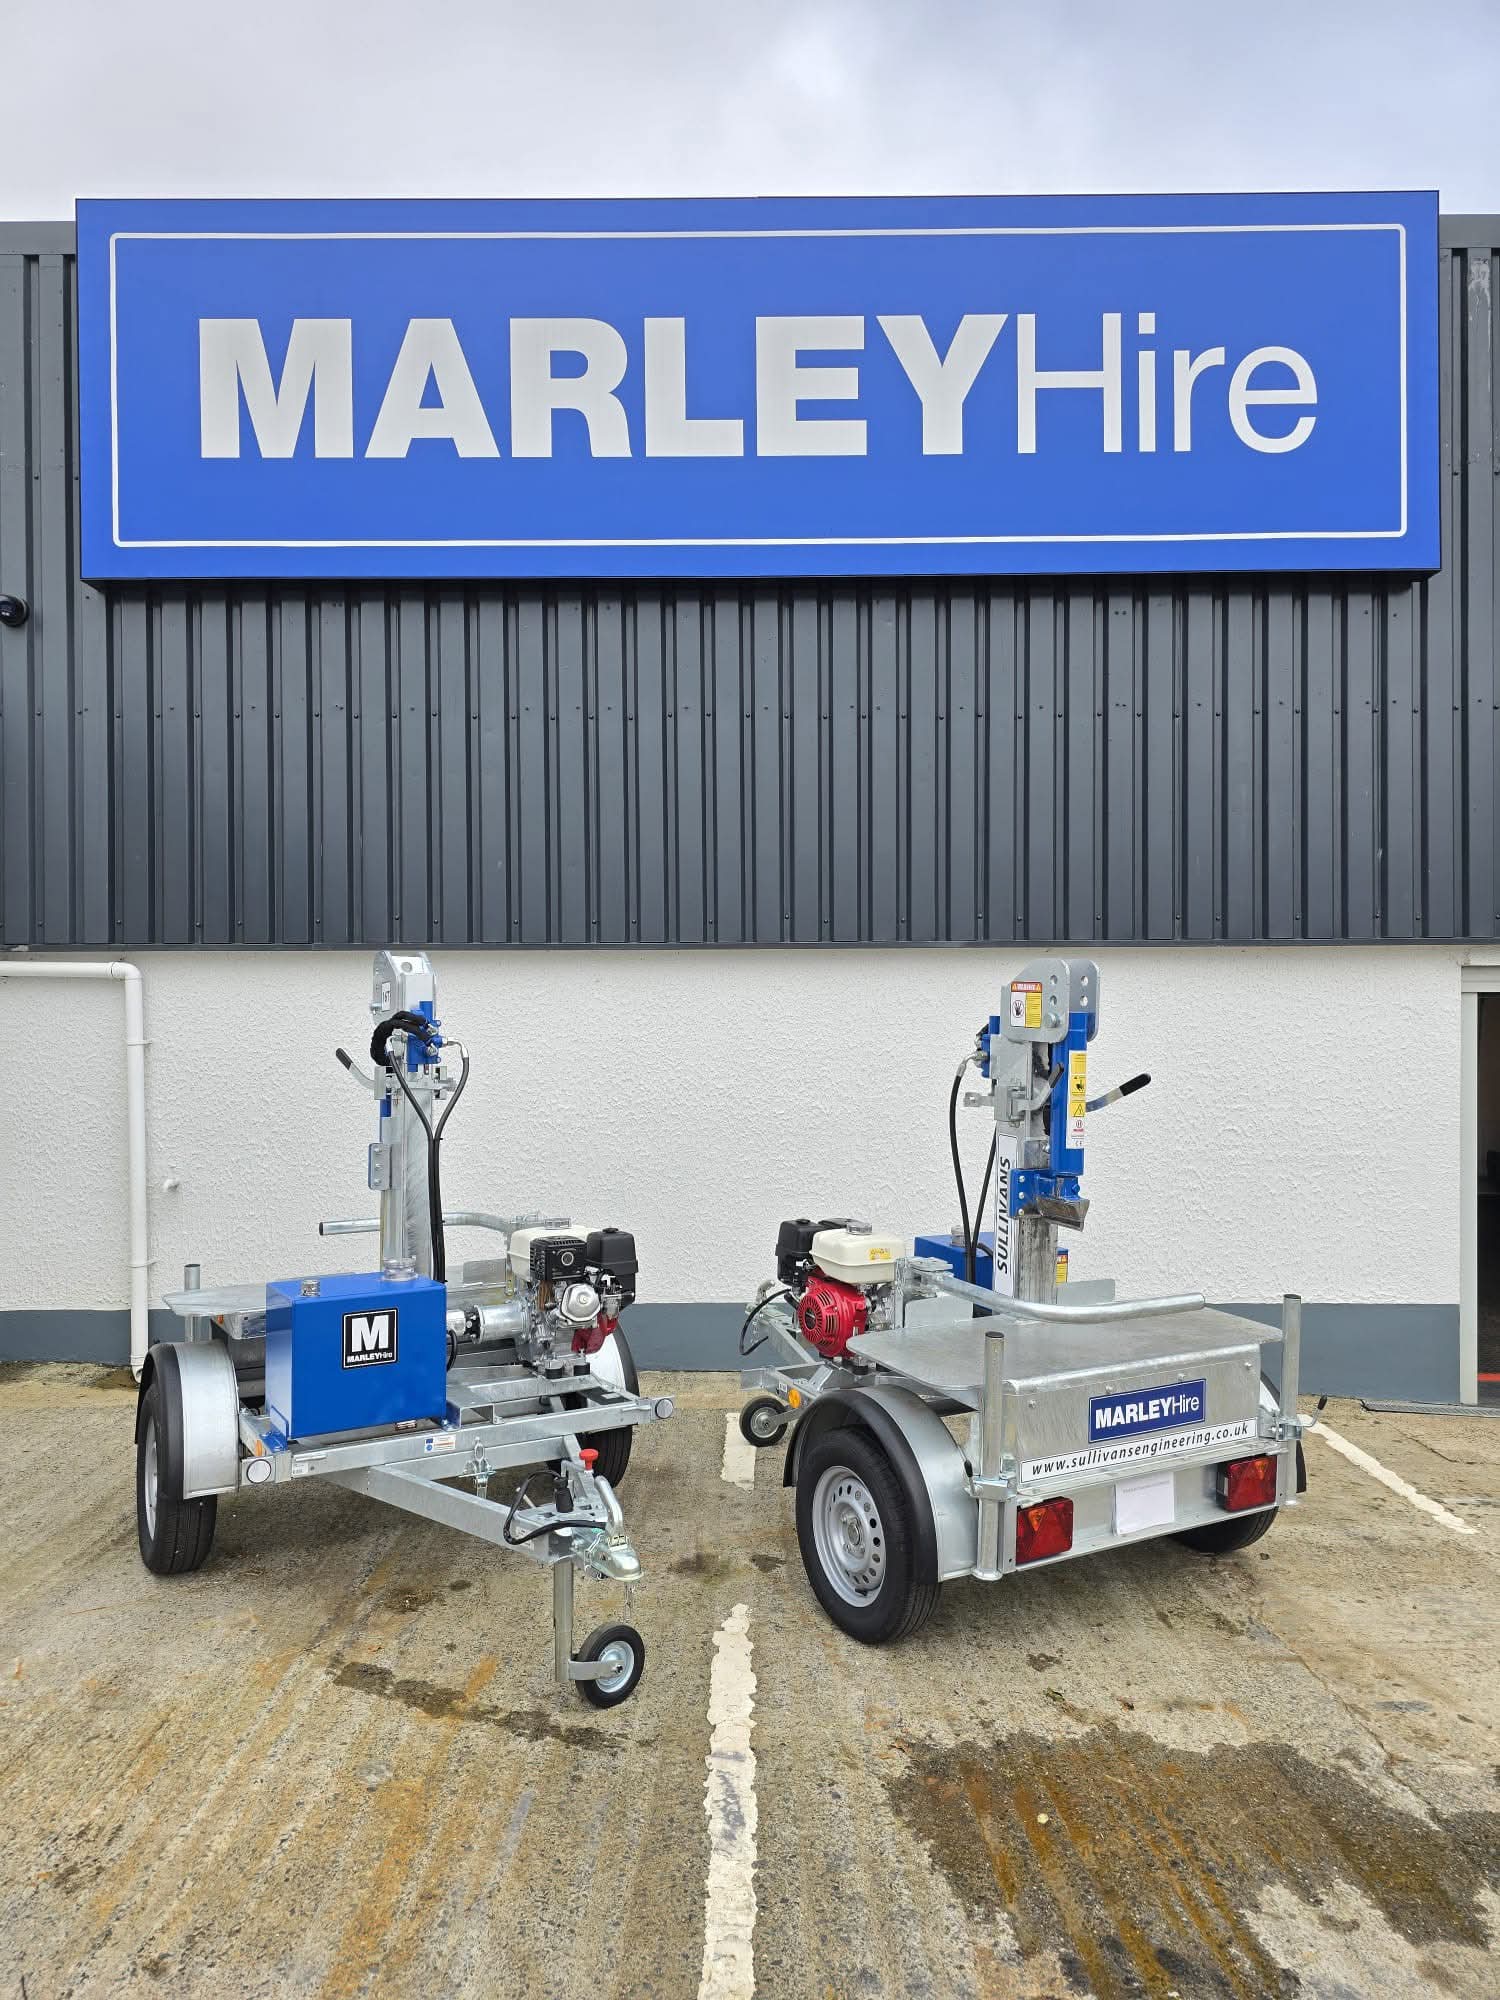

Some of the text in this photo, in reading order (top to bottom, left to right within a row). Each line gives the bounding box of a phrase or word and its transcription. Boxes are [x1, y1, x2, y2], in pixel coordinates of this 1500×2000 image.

[199, 313, 1317, 458] MARLEYHire
[997, 1156, 1010, 1274] SULLIVANS
[352, 1315, 389, 1352] M
[1095, 1394, 1200, 1430] MARLEYHire
[1032, 1421, 1249, 1476] www.sullivansengineering.co.uk
